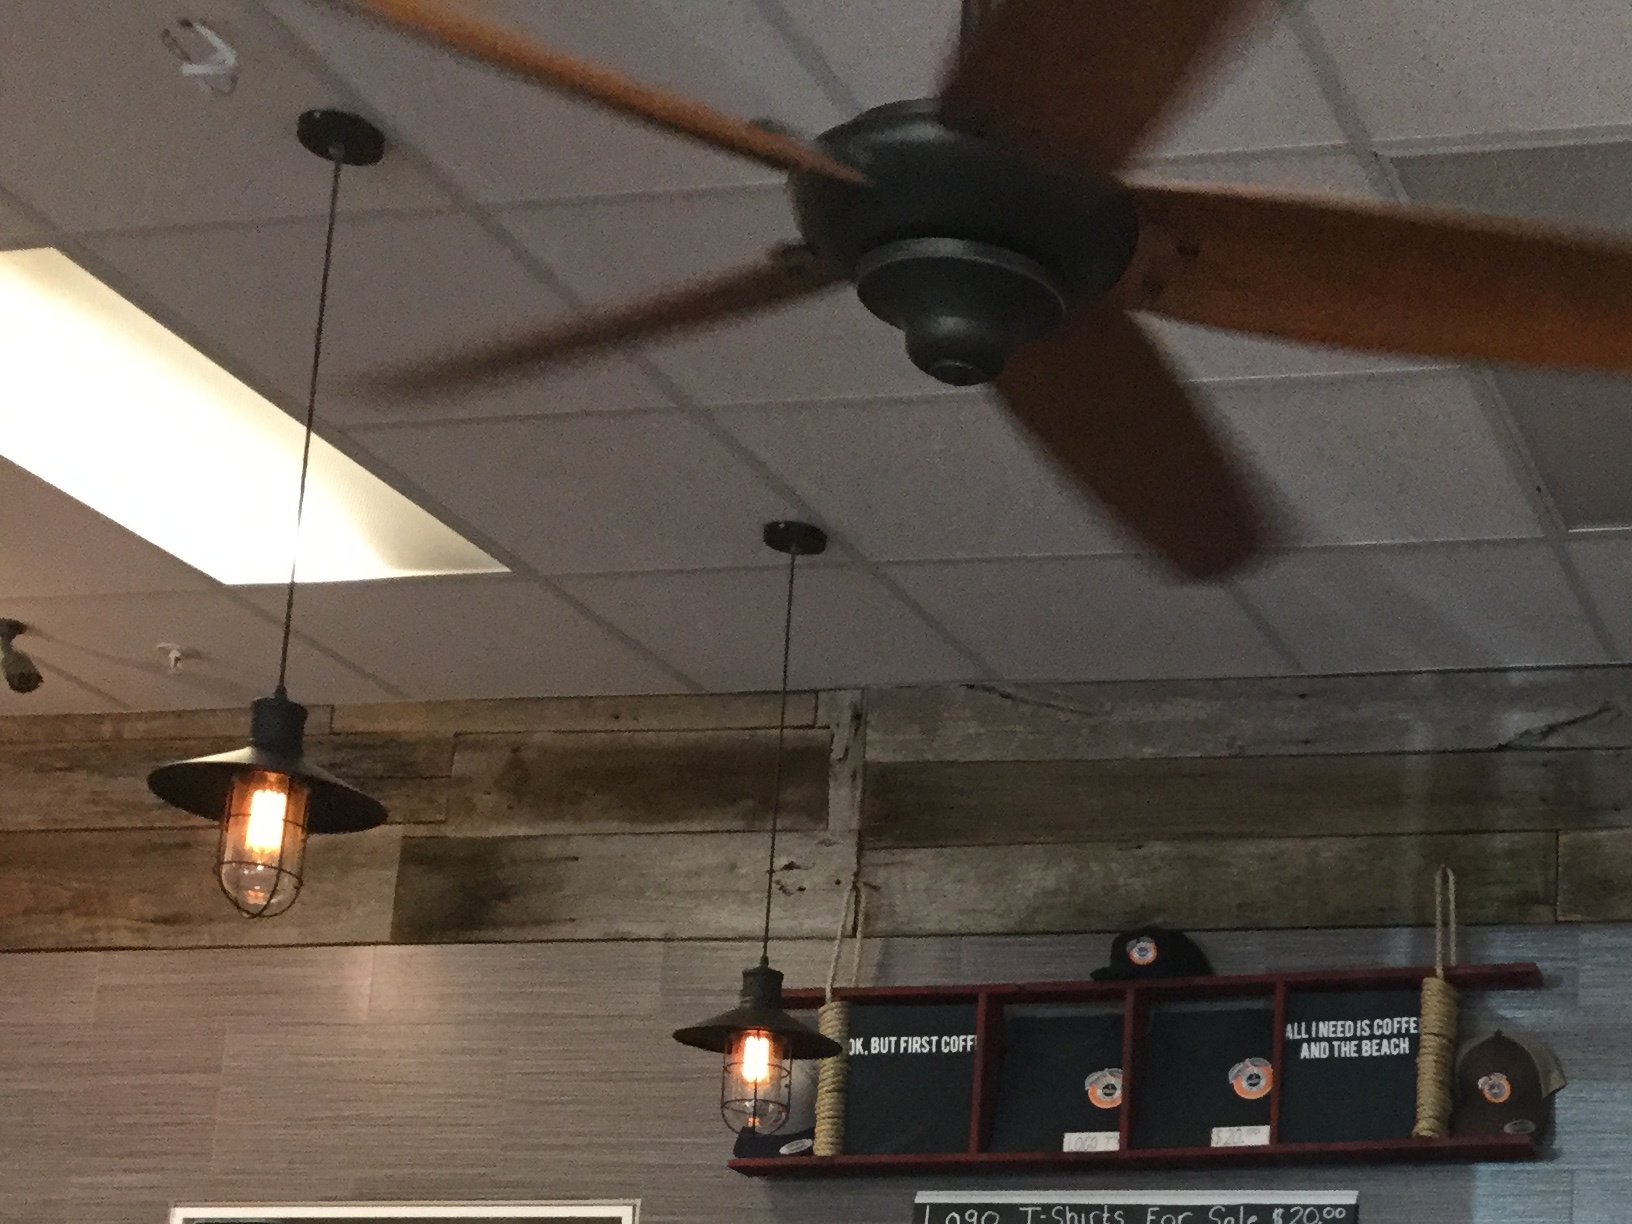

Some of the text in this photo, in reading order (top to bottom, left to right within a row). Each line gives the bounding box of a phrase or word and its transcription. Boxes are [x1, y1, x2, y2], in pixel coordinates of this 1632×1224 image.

[1286, 1016, 1419, 1039] ALL I NEED IS COFFE
[870, 1036, 897, 1054] BUT
[900, 1035, 939, 1053] FIRST
[941, 1034, 977, 1053] COFF
[1300, 1037, 1410, 1059] AND THE BEACH
